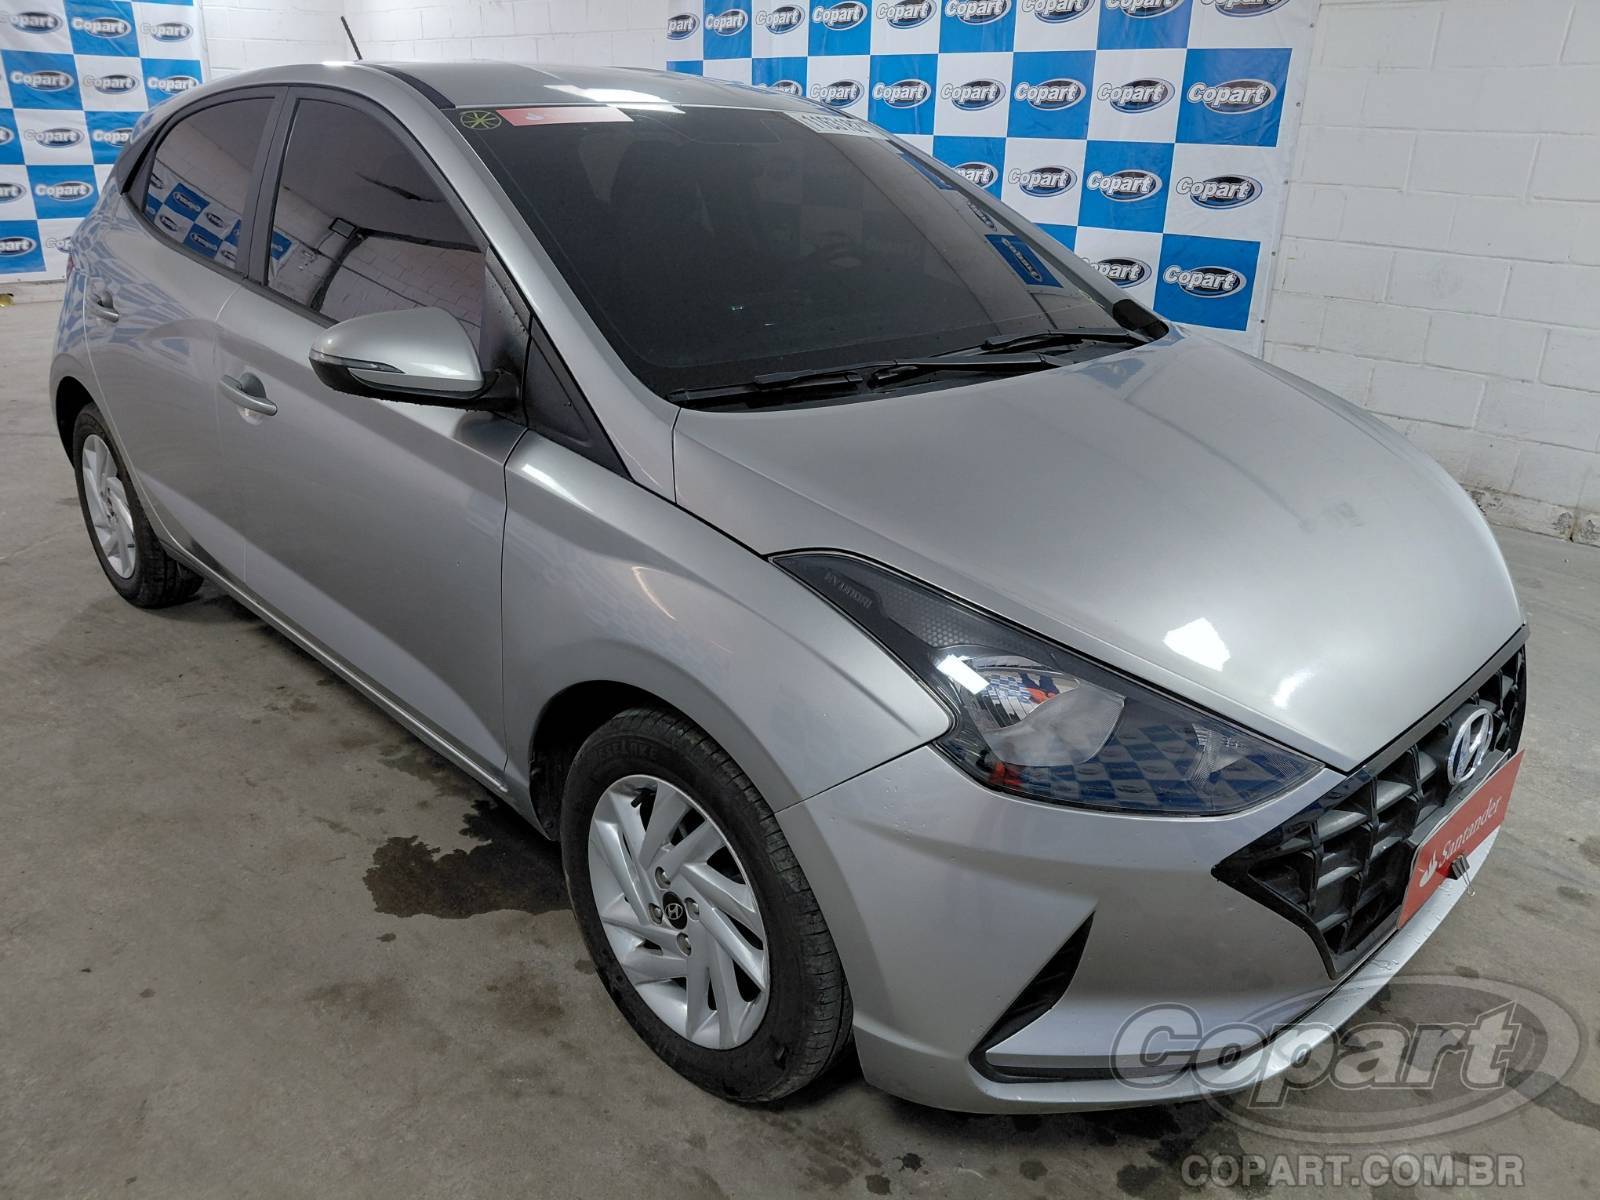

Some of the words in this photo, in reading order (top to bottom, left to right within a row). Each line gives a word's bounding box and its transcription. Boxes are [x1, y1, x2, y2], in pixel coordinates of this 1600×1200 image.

[812, 6, 860, 26] Copart
[876, 2, 928, 22] Copart
[945, 0, 1001, 19] Copart
[71, 17, 125, 37] Copart
[667, 18, 693, 34] part
[705, 12, 744, 30] Copart
[755, 11, 798, 29] Copart
[142, 23, 190, 41] Copart
[10, 71, 66, 88] Copart
[84, 75, 133, 92] Copart
[147, 77, 194, 93] Copart
[810, 83, 859, 104] Copart
[873, 82, 925, 102] Copart
[941, 82, 998, 104] Copart
[1014, 82, 1077, 104] Copart
[1097, 82, 1168, 107] Copart
[1187, 82, 1269, 107] Copart
[24, 129, 78, 146] Copart
[93, 130, 130, 145] Copa
[1008, 168, 1071, 189] Copart
[1087, 171, 1152, 196] Copart
[35, 184, 87, 198] Copart
[1176, 177, 1253, 202] Copart
[1163, 265, 1237, 290] Copart
[1438, 796, 1503, 868] Santander
